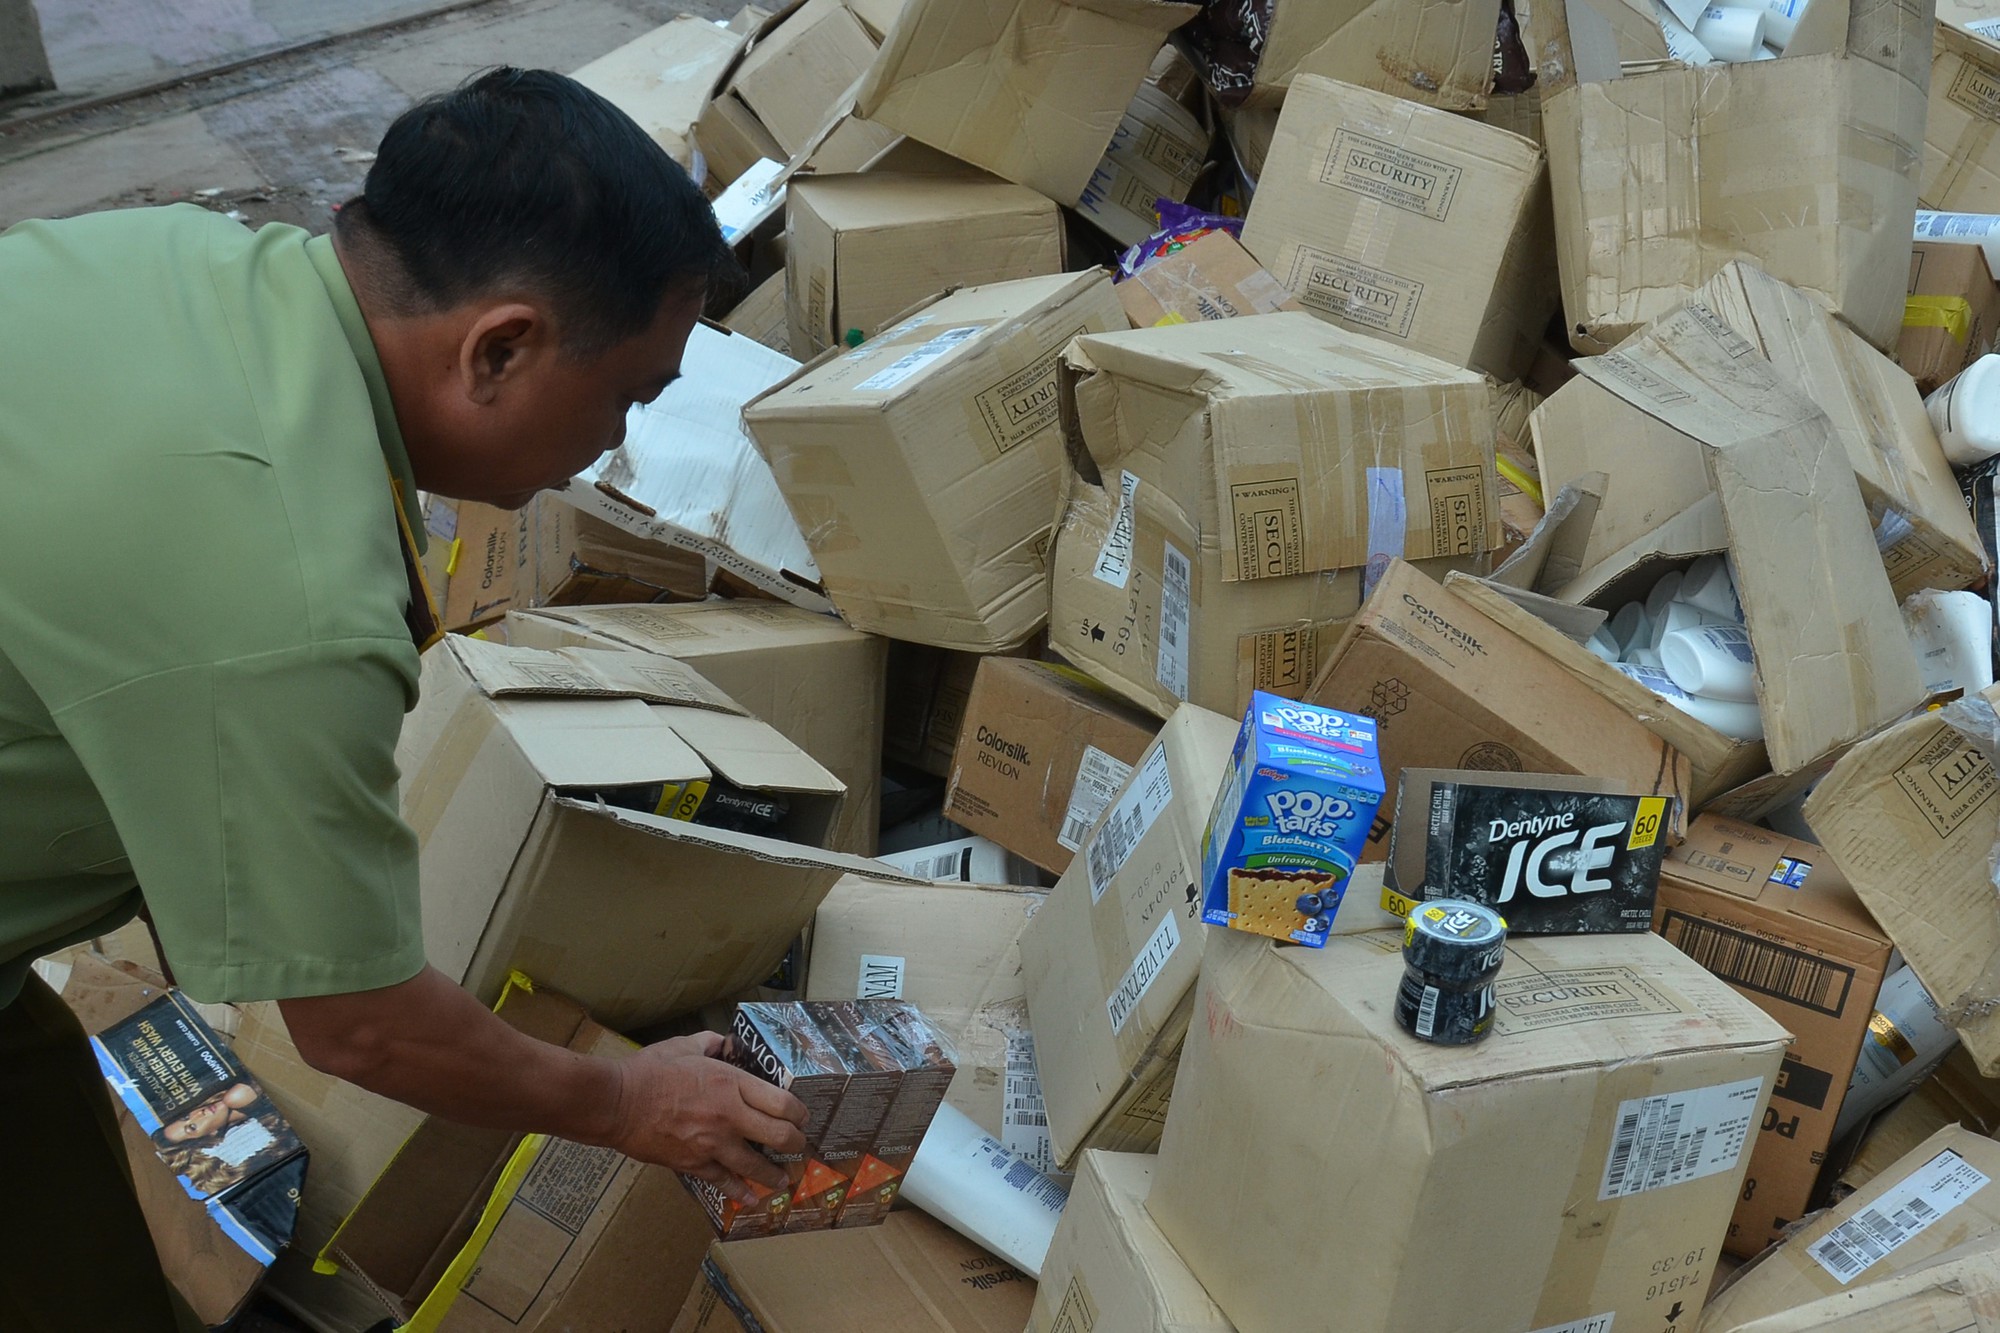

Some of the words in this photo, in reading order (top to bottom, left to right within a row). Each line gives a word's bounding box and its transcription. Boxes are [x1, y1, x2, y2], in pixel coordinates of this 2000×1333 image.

[1493, 52, 1502, 74] TRY
[1350, 154, 1432, 190] SECURITY
[1313, 270, 1394, 307] SECURITY
[1433, 473, 1474, 483] WARNING
[1241, 487, 1289, 498] WARNING
[595, 498, 636, 523] hair.
[1432, 497, 1442, 537] CONTENTS
[1100, 475, 1134, 576] T.I.VIETNAM
[1238, 513, 1249, 555] CONTENTS
[1290, 516, 1299, 550] CARTON
[482, 528, 498, 589] Colorsilk
[672, 533, 738, 569] nourish
[1248, 544, 1256, 563] SEAL
[1263, 515, 1283, 575] SECU
[707, 544, 799, 595] beautifully
[1081, 618, 1090, 637] UP
[1402, 593, 1488, 656] Colorsilk
[1410, 610, 1475, 657] REVLON
[1282, 631, 1296, 679] RITY
[1292, 722, 1343, 737] tarts
[976, 725, 1031, 767] Colorsilk
[1277, 746, 1337, 762] Blueberry
[977, 750, 1021, 780] REVLON
[1258, 768, 1291, 782] Kellogg's
[1976, 764, 1994, 782] TAPE
[680, 793, 698, 816] 60
[716, 794, 752, 808] Dentyne
[750, 802, 773, 817] ICE
[1433, 789, 1443, 810] CHILL
[1901, 773, 1948, 824] WARNING
[1966, 779, 1993, 805] SEALED
[1430, 812, 1441, 836] ARCTIC
[1949, 801, 1969, 821] WITH
[1276, 815, 1337, 837] tarts
[1489, 812, 1574, 843] Dentyne
[1634, 814, 1659, 836] 60
[1262, 835, 1331, 854] Blueberry
[1632, 834, 1654, 845] PIECES
[1267, 856, 1318, 866] Unfrosted
[1497, 821, 1627, 903] ICE
[1388, 894, 1406, 916] 60
[1620, 909, 1638, 918] ARCTIC
[1638, 909, 1651, 918] CHILL
[1303, 918, 1318, 932] 8
[1444, 909, 1478, 935] ICE
[1111, 926, 1174, 1028] T.I.VIETNAM
[1504, 984, 1622, 1009] SECURITY
[138, 1020, 164, 1047] WASH
[132, 1036, 152, 1061] HAIR
[161, 1045, 188, 1076] EVERY
[734, 1014, 785, 1087] REVLON
[128, 1051, 150, 1082] PROVEN
[201, 1050, 229, 1081] SHAMPOO
[144, 1077, 176, 1111] CLINICALLY
[149, 1057, 190, 1105] HEALTHIER
[181, 1068, 203, 1097] WITH
[1742, 1178, 1757, 1200] 8
[1650, 1247, 1706, 1277] 19/35
[1646, 1270, 1700, 1301] 74516
